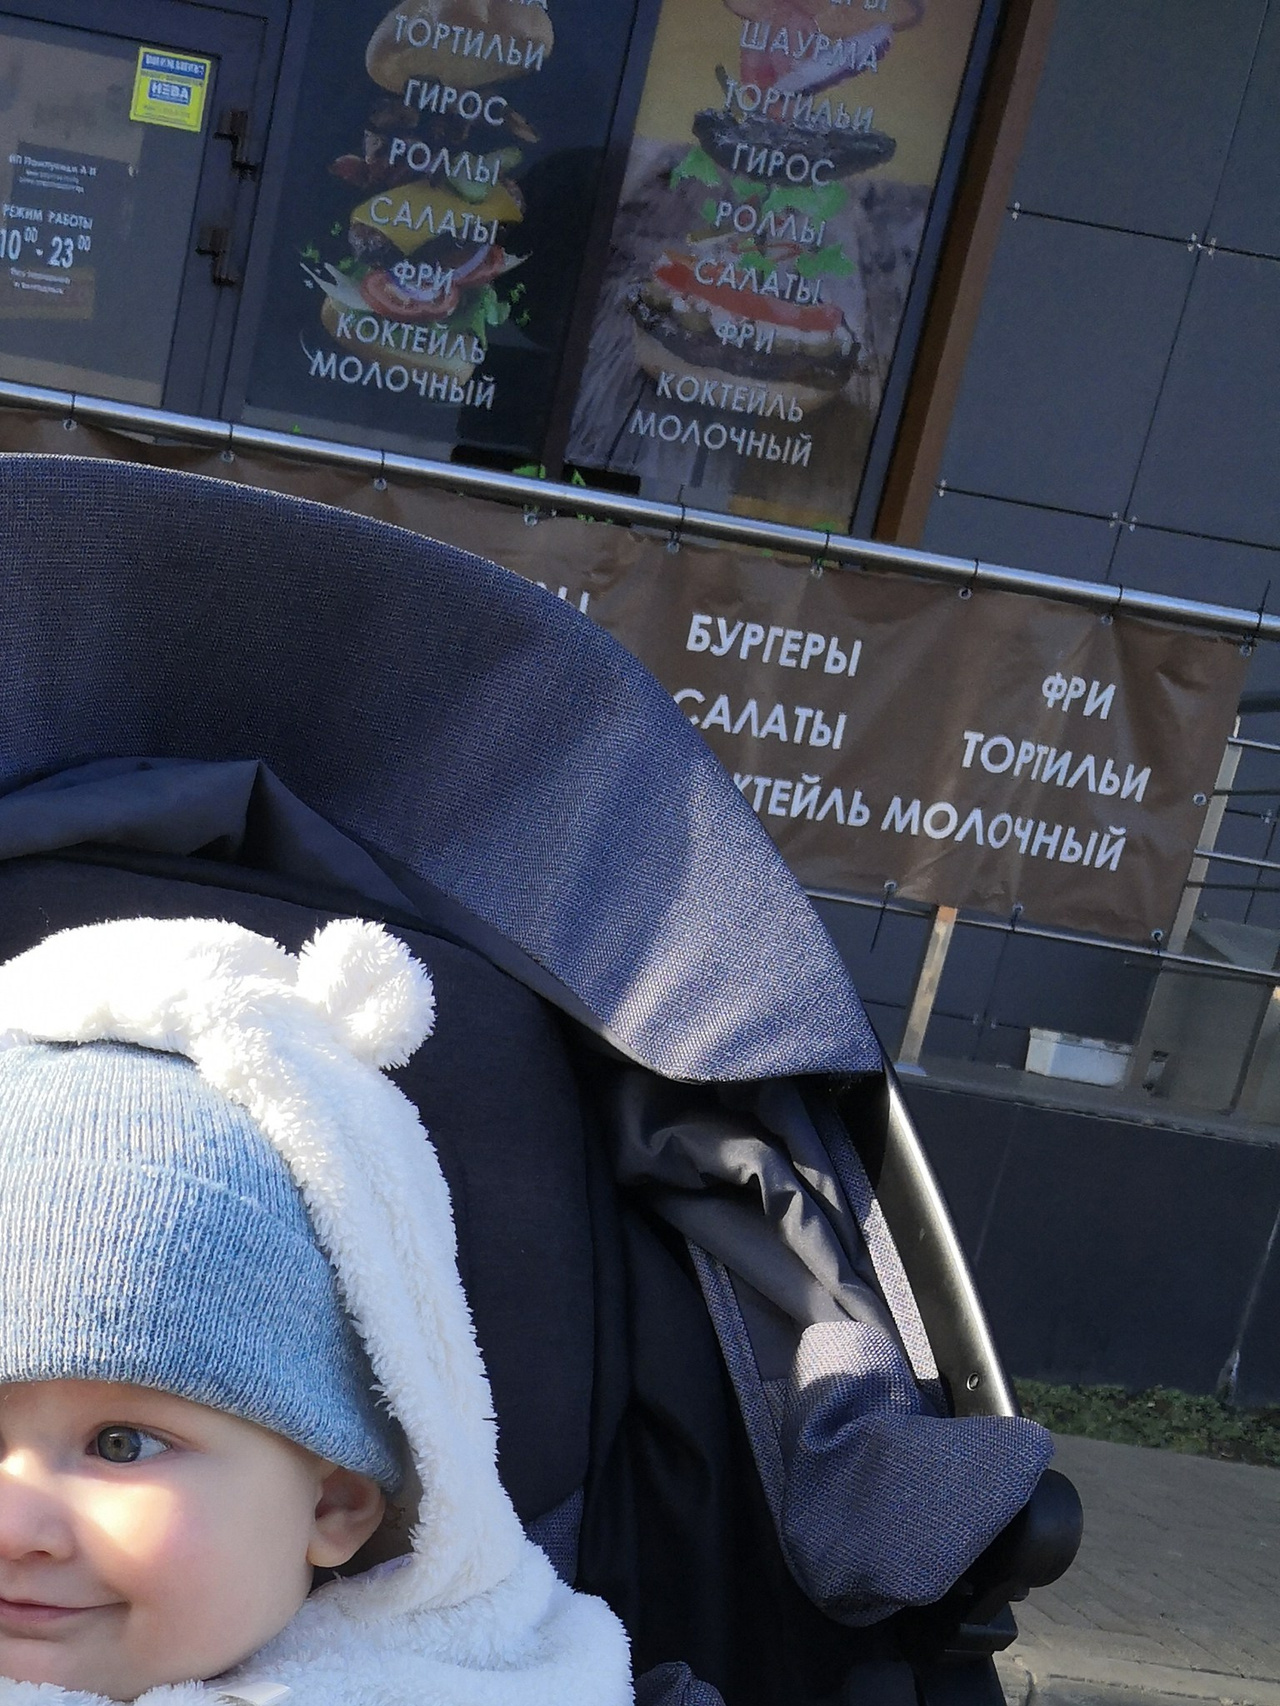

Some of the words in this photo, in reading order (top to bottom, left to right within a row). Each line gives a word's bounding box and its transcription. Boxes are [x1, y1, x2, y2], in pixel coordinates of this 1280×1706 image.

[394, 14, 547, 72] ТОРТИЛЬИ
[740, 20, 878, 73] ШАУРМА
[402, 79, 508, 126] ГИРОС
[724, 80, 875, 131] ТОРТИЛЬИ
[388, 137, 502, 186] РОЛЛЫ
[730, 143, 835, 186] ГИРОС
[2, 203, 44, 222] РЕЖИМ
[47, 210, 94, 231] РАБОТЫ
[369, 197, 500, 246] САЛАТЫ
[715, 201, 827, 244] РОЛЛЫ
[392, 260, 455, 297] ФРИ
[694, 258, 823, 305] САЛАТЫ
[335, 312, 486, 366] КОКТЕЙЛЬ
[716, 320, 776, 356] ФРИ
[308, 350, 497, 411] МОЛОЧНЫЙ
[655, 370, 804, 424] КОКТЕЙЛЬ
[630, 410, 813, 468] МОЛОЧНЫЙ
[686, 613, 862, 678] БУРГЕРЫ
[673, 688, 848, 750] САЛАТЫ
[1041, 672, 1116, 721] ФРИ
[960, 731, 1151, 802] ТОРТИЛЬИ
[732, 771, 870, 827] ТЕЙЛЬ
[880, 795, 1128, 873] МОЛОЧНЫЙ
